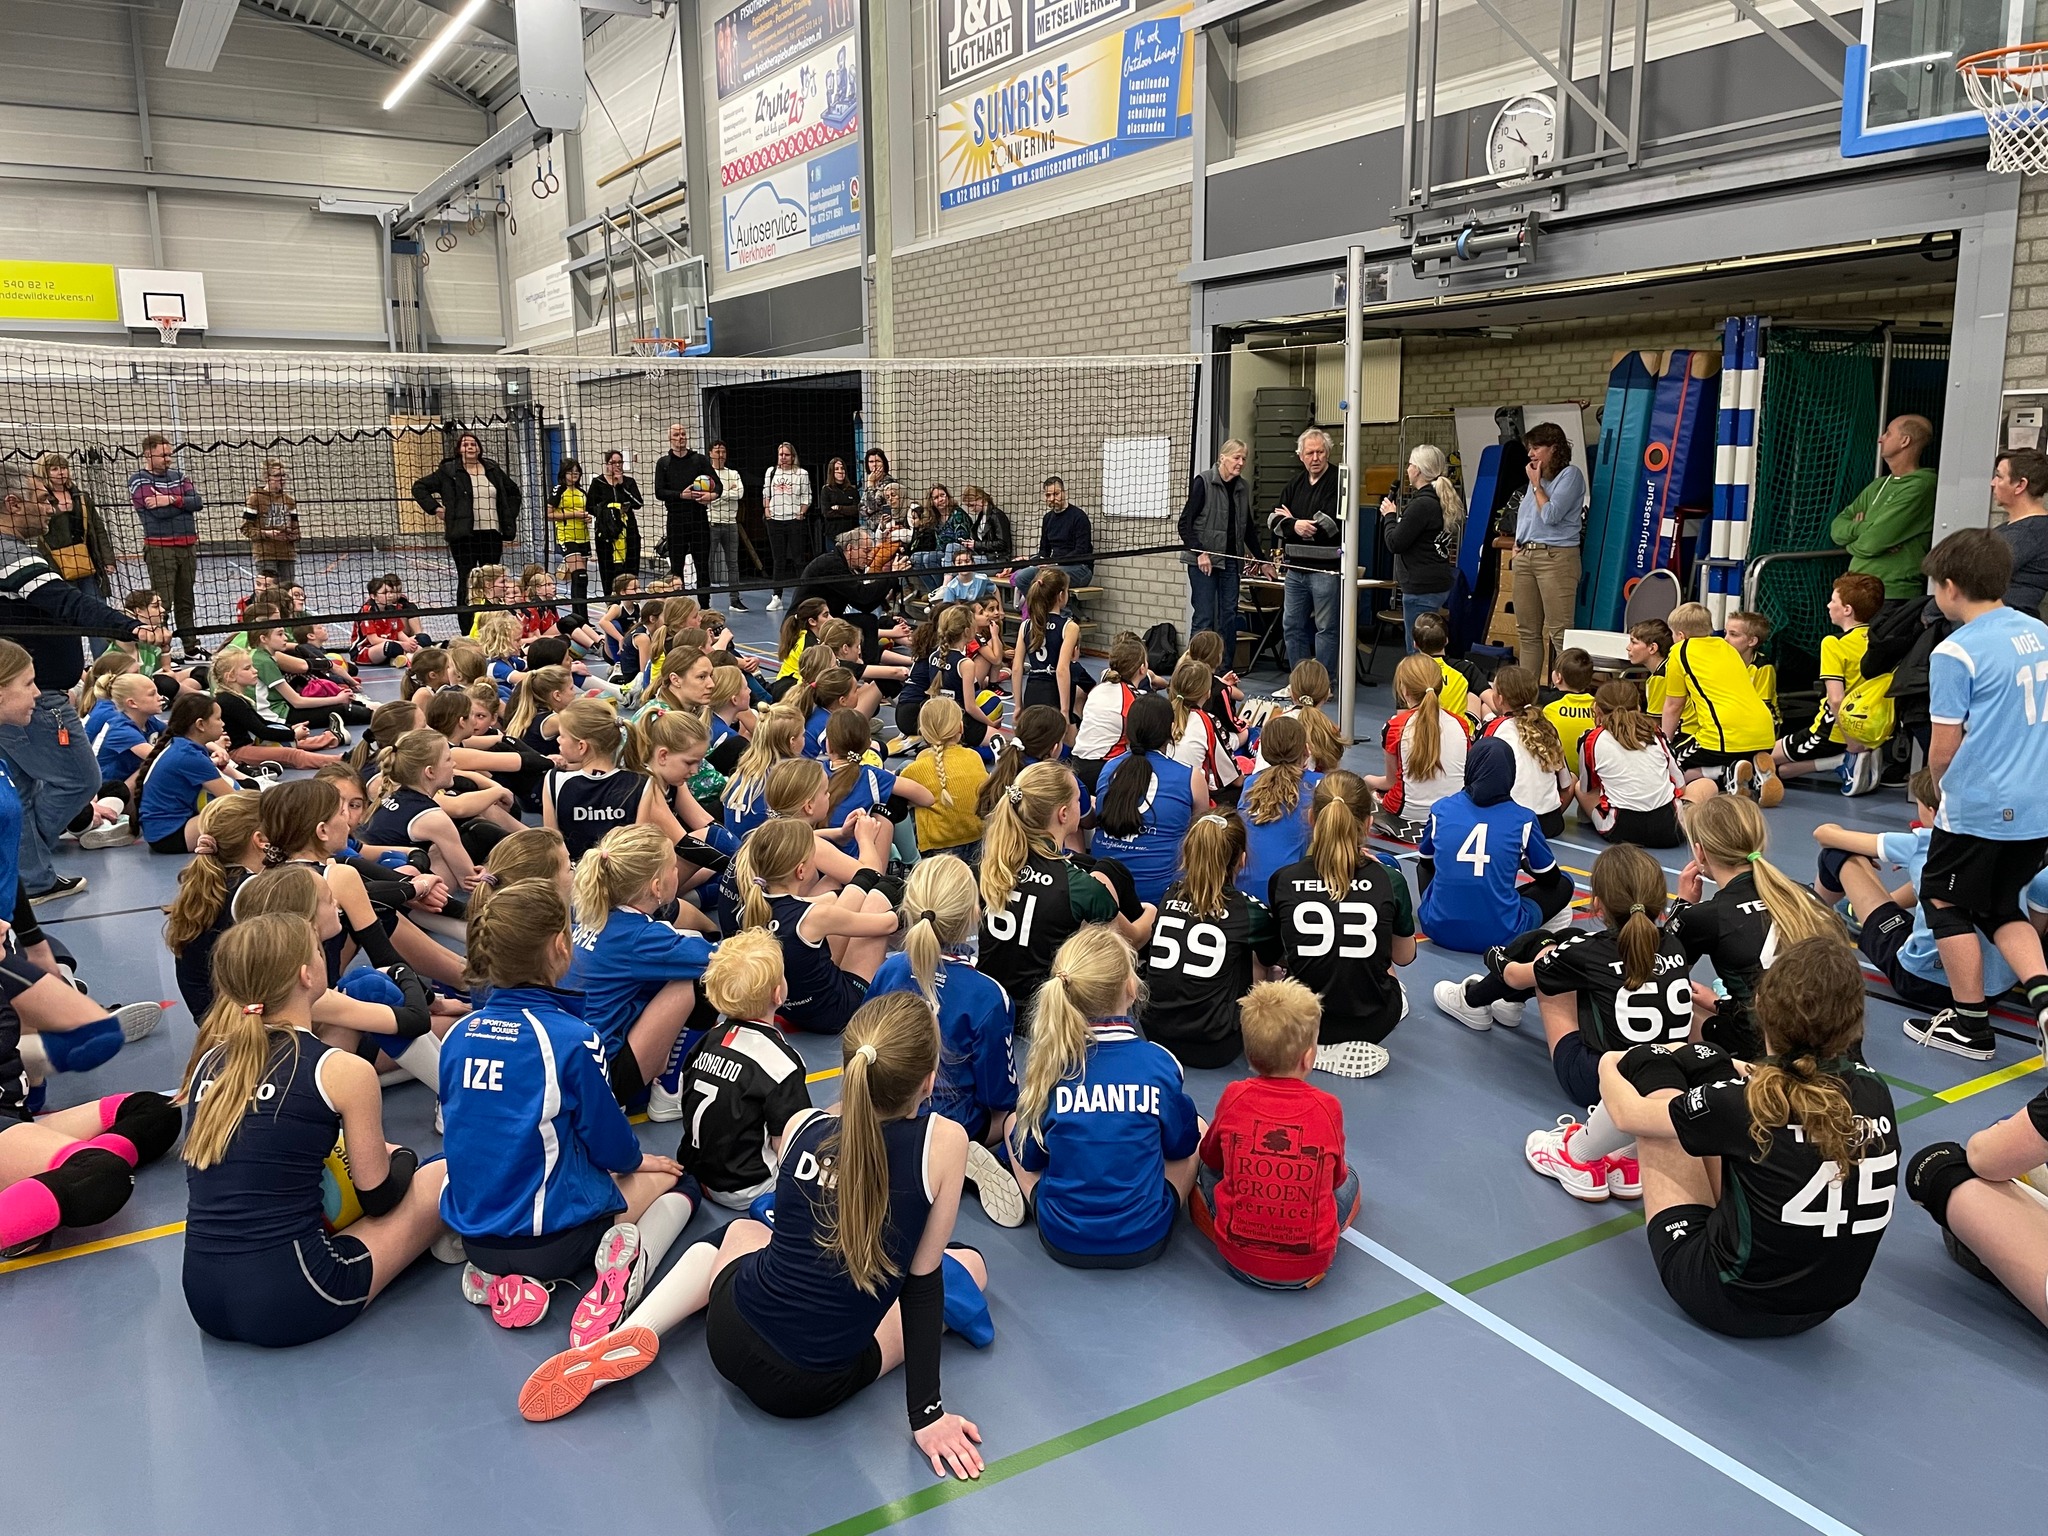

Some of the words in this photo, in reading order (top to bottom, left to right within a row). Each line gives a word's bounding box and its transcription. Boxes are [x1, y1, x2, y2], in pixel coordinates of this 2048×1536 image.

[1037, 0, 1118, 36] METSELWERK
[1147, 22, 1161, 44] ook
[950, 23, 1011, 75] LIGTHART
[1123, 52, 1152, 77] Outdoor
[973, 62, 1070, 147] SUNRISE
[1501, 126, 1509, 136] 10
[1547, 132, 1553, 142] 3
[991, 129, 1056, 170] ZONWERING
[1497, 143, 1503, 152] 9
[1542, 150, 1548, 158] 4
[957, 188, 968, 203] 072
[1012, 143, 1110, 187] www.sunrisezonwering.nl
[1500, 159, 1505, 168] 8
[736, 209, 798, 249] Autoservice
[738, 243, 776, 265] Werkhoven
[4, 280, 24, 288] 540
[28, 281, 41, 289] 82
[573, 806, 625, 821] Dinto
[1456, 823, 1491, 877] 4
[987, 890, 1037, 947] 61
[1292, 901, 1378, 958] 93
[571, 922, 598, 952] OFIE
[1150, 915, 1227, 978] 59
[481, 1018, 522, 1028] SPORTSHOP
[1615, 978, 1694, 1043] 69
[463, 1057, 505, 1092] IZE
[691, 1051, 743, 1083] RONALDO
[691, 1079, 719, 1149] 7
[1056, 1084, 1160, 1115] DAANTJE
[1238, 1156, 1313, 1182] ROOD
[1236, 1179, 1313, 1202] GROEN
[1781, 1149, 1898, 1238] 45
[1235, 1200, 1309, 1219] service
[1665, 1220, 1688, 1232] erima
